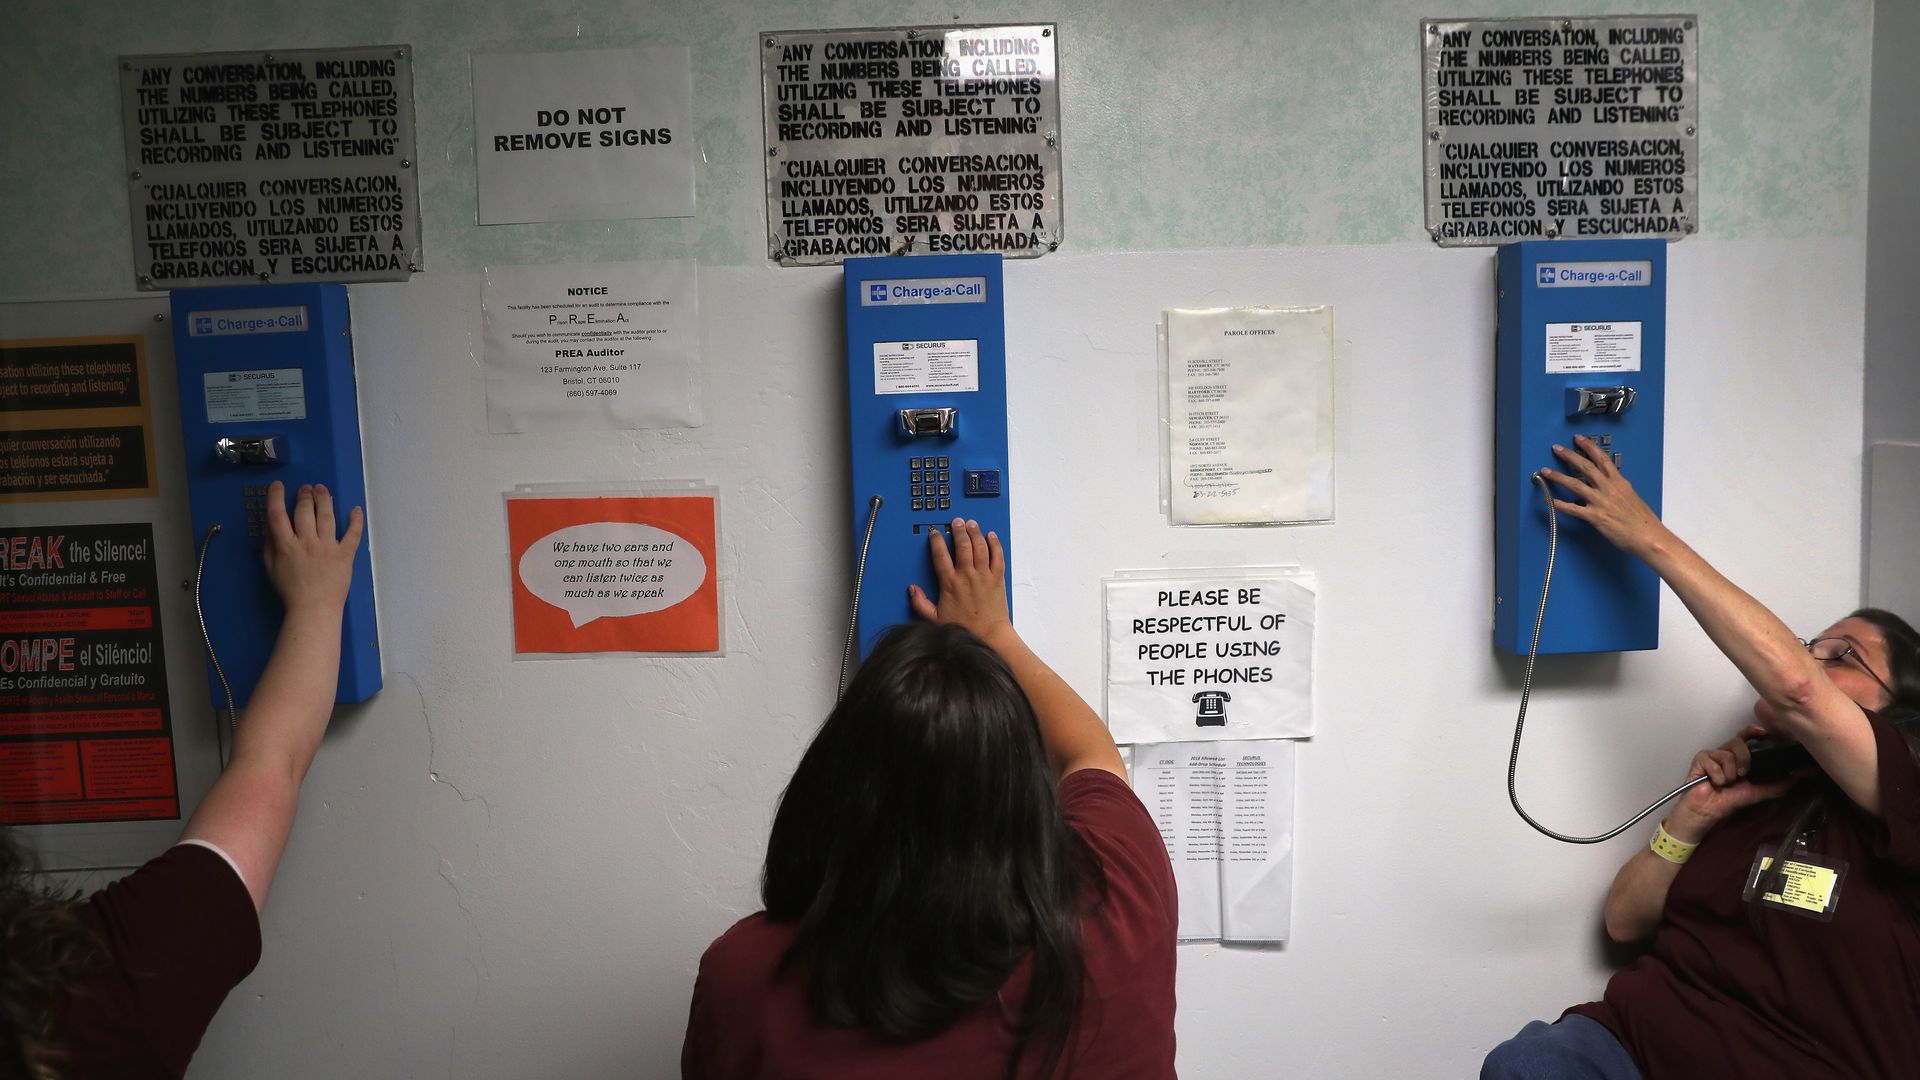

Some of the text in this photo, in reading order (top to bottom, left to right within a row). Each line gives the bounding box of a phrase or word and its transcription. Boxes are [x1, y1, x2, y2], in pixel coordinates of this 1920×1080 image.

[1482, 29, 1598, 48] CONVERSATION,
[1609, 27, 1683, 44] INCLUDING
[825, 38, 949, 60] CONVERSATION,
[960, 38, 1039, 56] INCLUDING
[1441, 47, 1684, 67] THE NUMBERS BEING CALLED,
[183, 62, 306, 83] CONVERSATION,
[316, 60, 395, 79] INCLUDING
[777, 64, 809, 81] THE
[821, 62, 899, 79] NUMBERS
[912, 60, 960, 77] BEING
[1438, 66, 1684, 87] UTILIZING THESE TELEPHONES
[137, 80, 397, 105] THE NUMBERS BEING CALLED,
[778, 78, 1041, 100] UTILIZING THESE TELEPHONES
[1438, 86, 1683, 106] SHALL BE SUBJECT TO
[138, 101, 397, 126] UTILIZING THESE TELEPHONES
[537, 107, 626, 126] DO NOT
[778, 98, 1040, 122] SHALL BE SUBJECT TO
[140, 119, 396, 145] SHALL BE SUBJECT TO
[494, 128, 671, 151] REMOVE SIGNS
[779, 122, 882, 141] RECORDING
[896, 120, 932, 137] AND
[899, 154, 1043, 175] CONVERSACION,
[782, 174, 1044, 198] INCLUYENDO LOS NUMEROS
[782, 194, 1043, 218] LLAMADOS, UTILIZANDO ESTOS
[783, 213, 1043, 236] TELEFONOS SERA SUJETA A
[784, 236, 890, 257] GRABACION
[904, 236, 915, 253] Y
[568, 287, 608, 296] NOTICE
[556, 349, 624, 358] PREA Auditor
[26, 363, 59, 378] utilizing
[61, 362, 84, 376] these
[86, 361, 131, 376] telephones
[554, 365, 591, 374] Farmington
[20, 382, 29, 393] to
[31, 381, 70, 396] recording
[71, 380, 87, 392] and
[567, 390, 584, 398] (860)
[79, 435, 120, 448] utilizando
[80, 454, 106, 468] sujeta
[109, 455, 113, 464] a
[37, 475, 42, 487] y
[45, 474, 57, 485] ser
[70, 541, 90, 563] the
[95, 539, 147, 561] Silence!
[553, 541, 674, 553] We have two ears and
[554, 557, 672, 568] one mouth so that we
[19, 572, 85, 586] Confidential
[90, 571, 97, 583] &
[102, 571, 126, 583] Free
[586, 573, 616, 583] listen
[619, 573, 648, 583] twice
[651, 574, 664, 582] as
[564, 588, 664, 599] much as we speak
[1159, 588, 1261, 606] PLEASE BE
[1133, 614, 1286, 634] RESPECTFUL OF
[80, 645, 91, 666] el
[96, 642, 151, 665] Siléncio!
[1139, 641, 1280, 660] PEOPLE USING
[1, 673, 145, 689] Es Confidencial y Gratuito
[1147, 667, 1272, 685] THE PHONES
